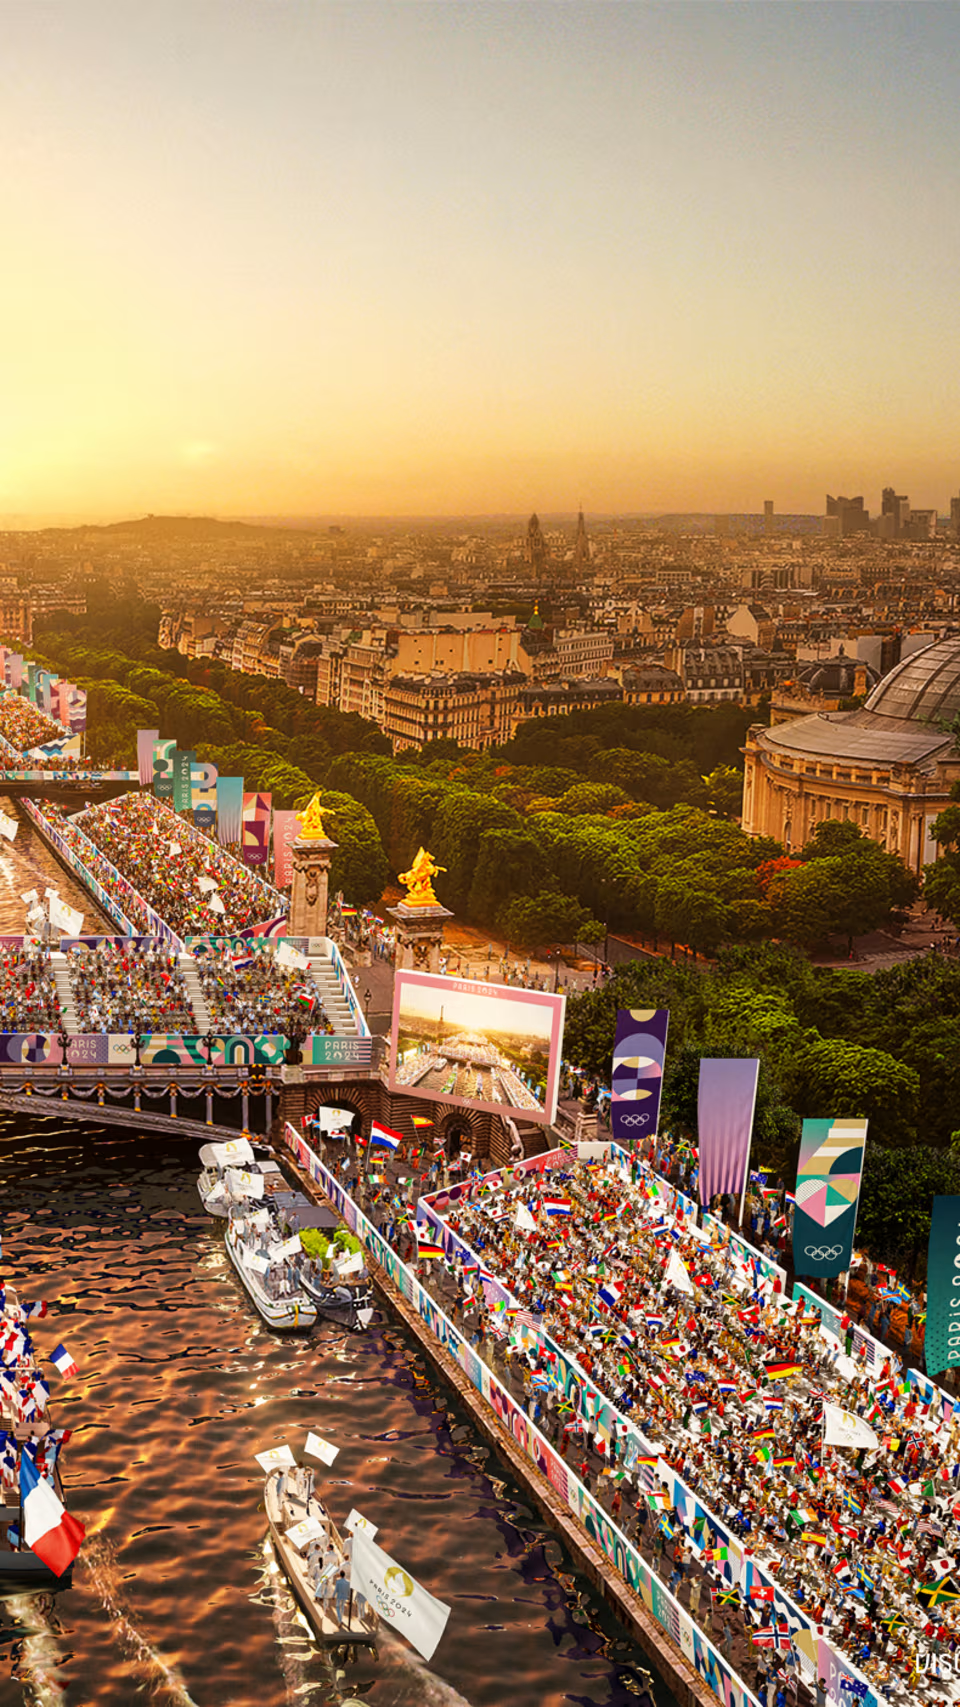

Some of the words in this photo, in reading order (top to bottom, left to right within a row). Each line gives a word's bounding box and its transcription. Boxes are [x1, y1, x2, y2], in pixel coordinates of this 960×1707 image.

[70, 1039, 97, 1049] ARIS
[324, 1040, 360, 1050] PARIS
[324, 1050, 360, 1061] 2024
[368, 1578, 390, 1600] PARIS
[390, 1598, 412, 1618] 2024
